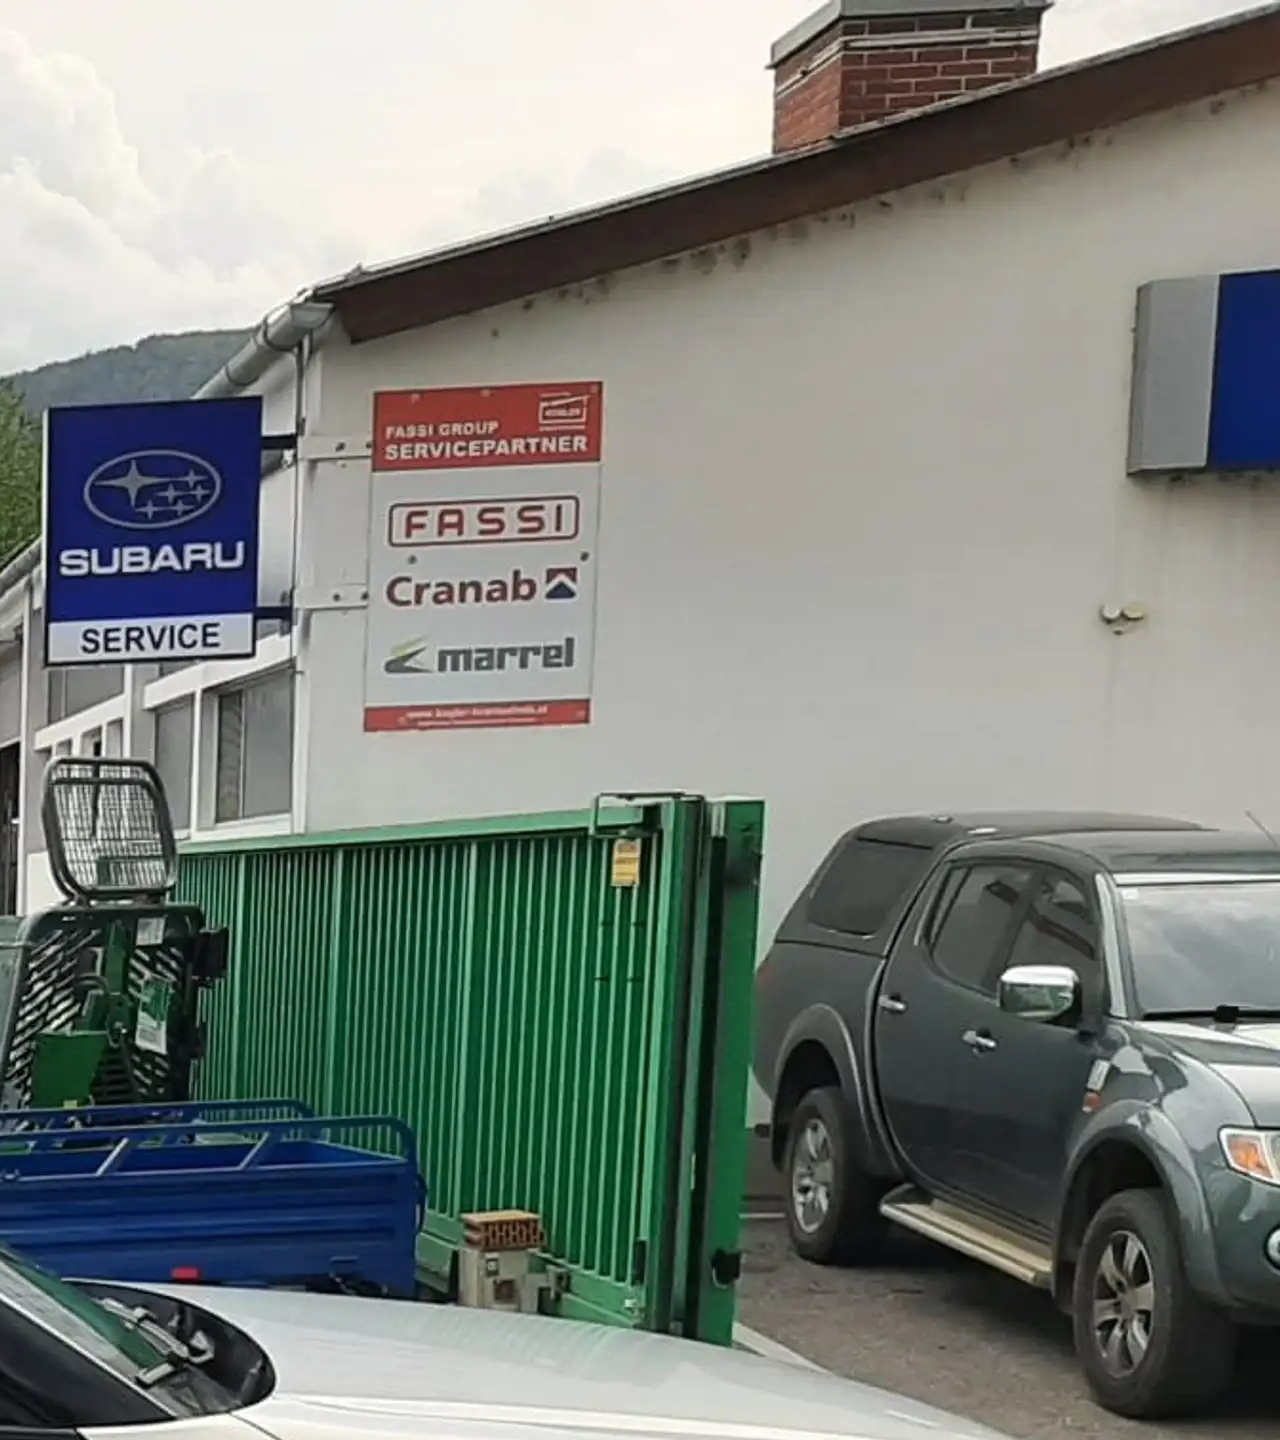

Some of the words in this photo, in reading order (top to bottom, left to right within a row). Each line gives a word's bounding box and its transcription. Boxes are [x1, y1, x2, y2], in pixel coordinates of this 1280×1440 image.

[385, 424, 433, 440] FASSI
[439, 421, 499, 436] GROUP
[385, 435, 588, 461] SERVICEPARTNER
[404, 503, 563, 539] FASSI
[59, 541, 245, 576] SUBARU
[386, 569, 538, 607] Cranab
[81, 622, 221, 655] SERVICE
[438, 637, 575, 672] marrel
